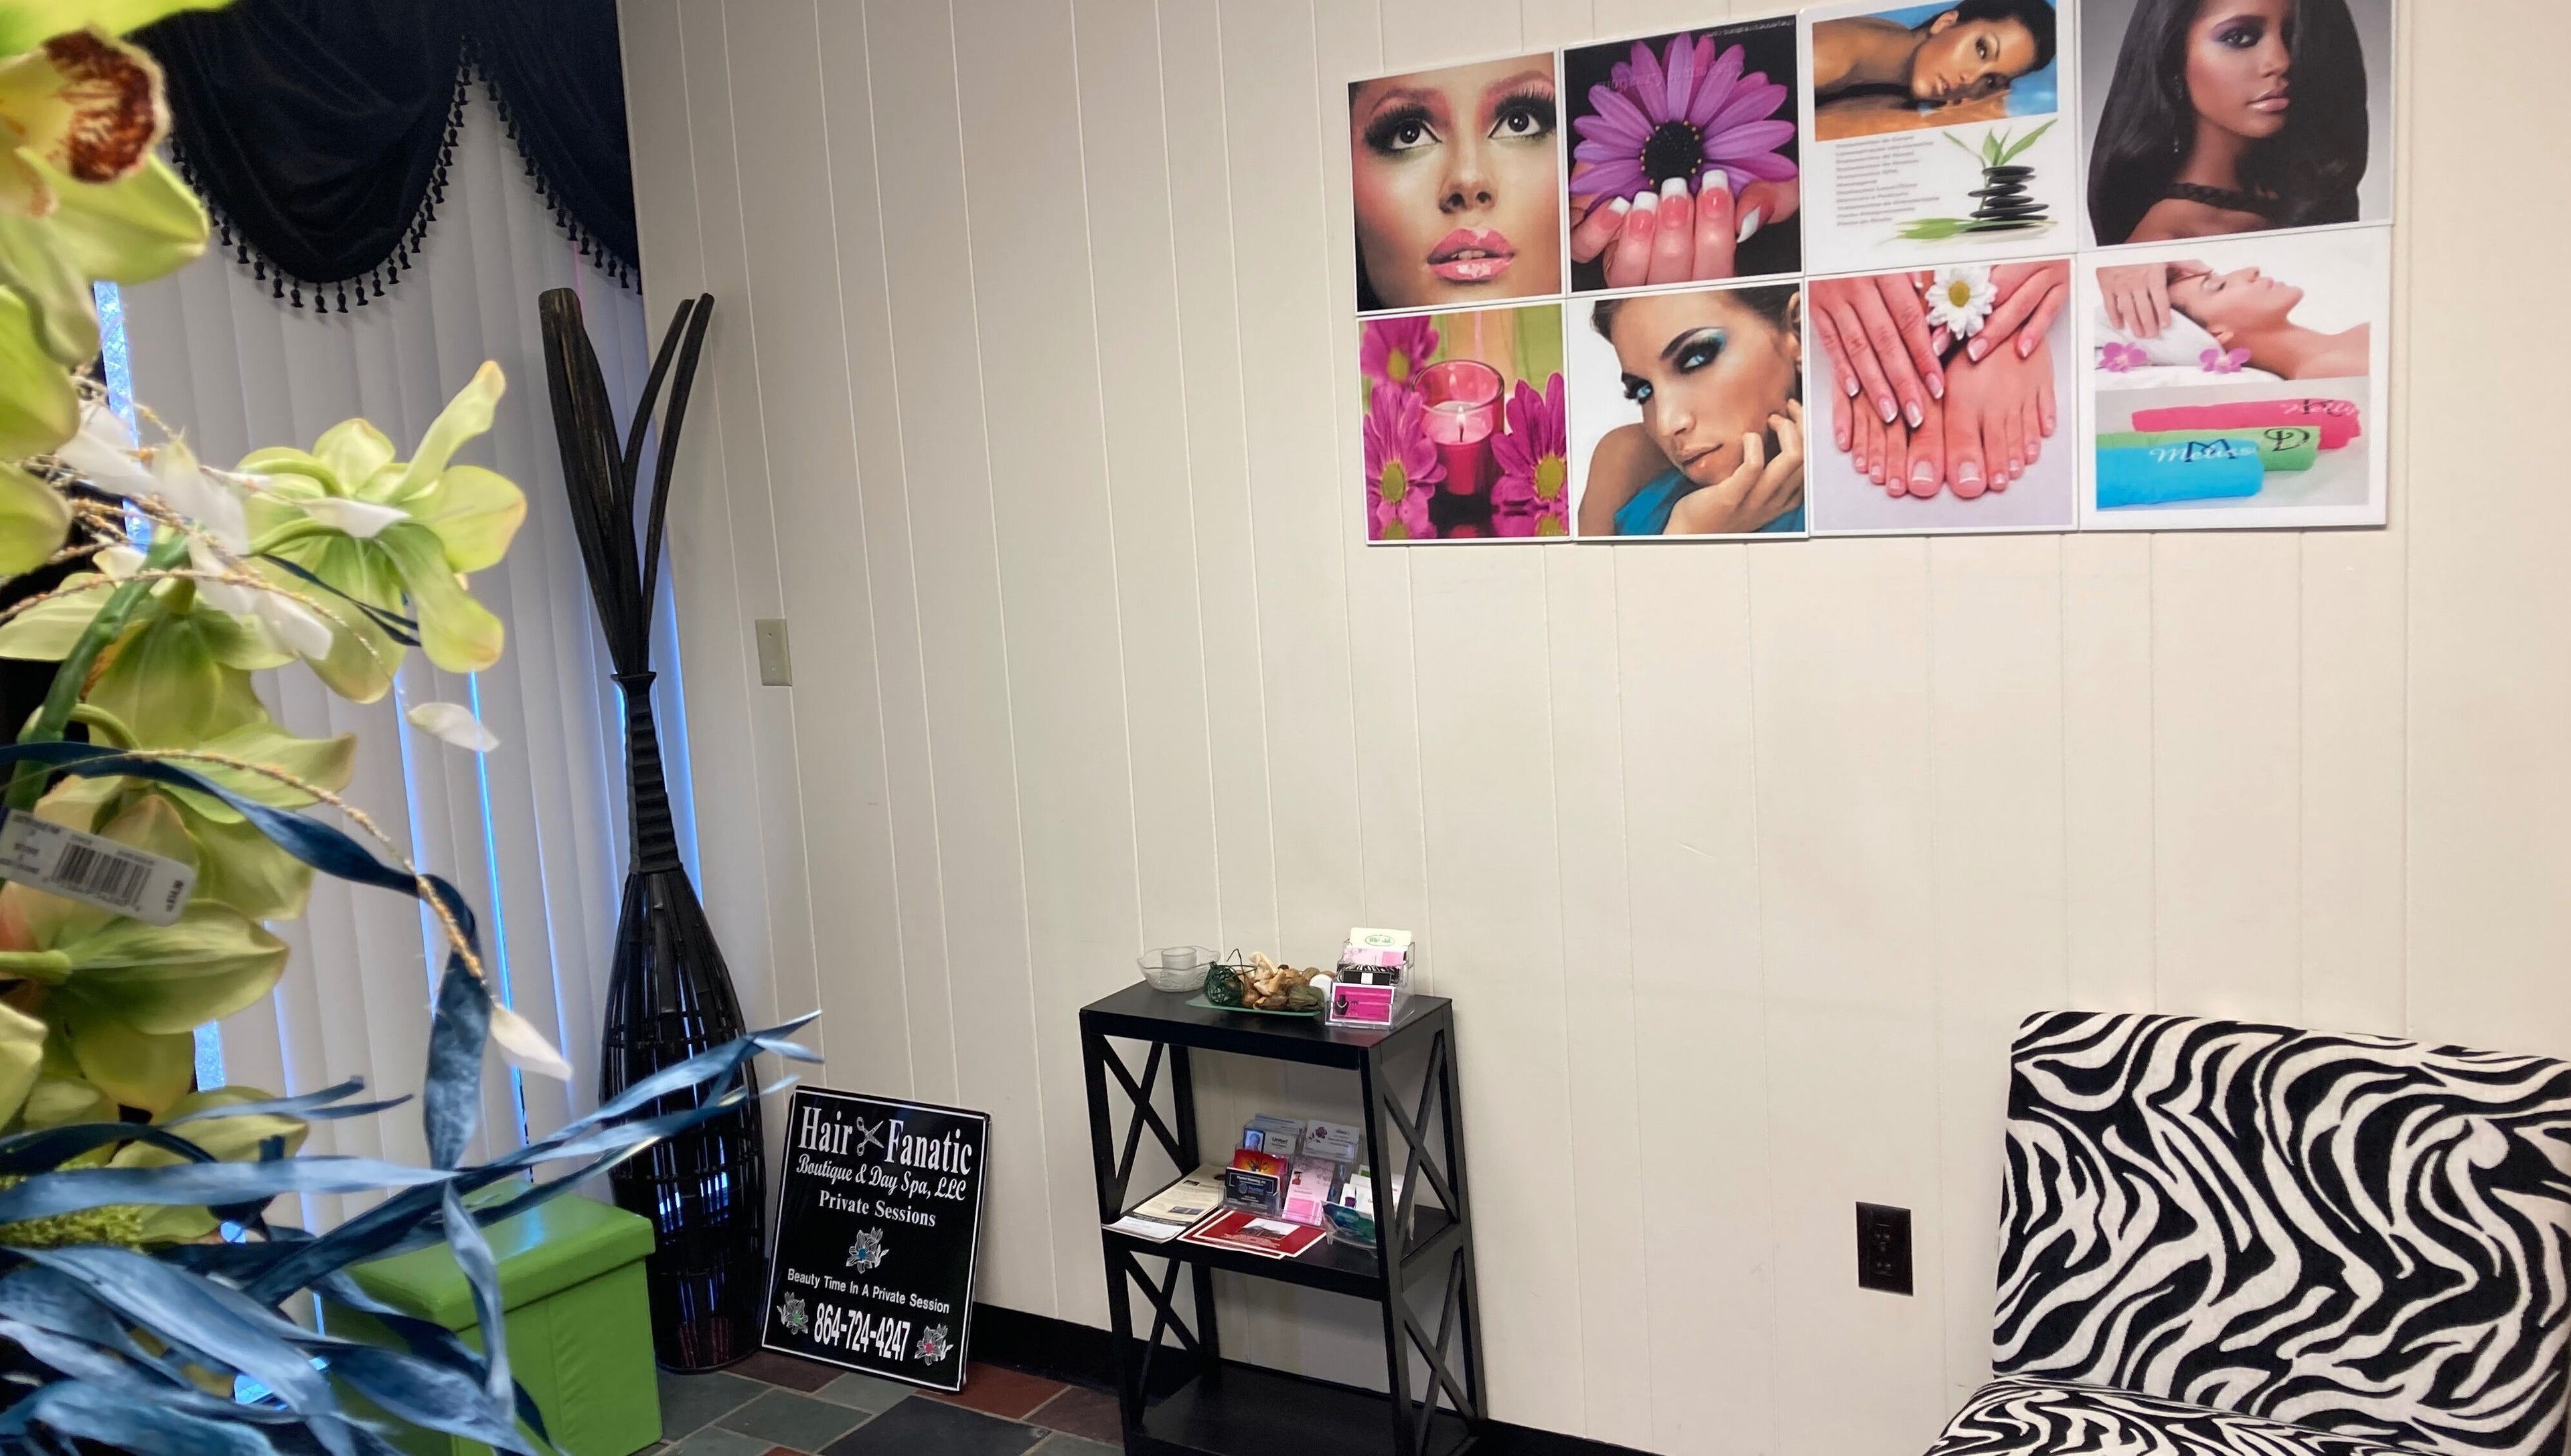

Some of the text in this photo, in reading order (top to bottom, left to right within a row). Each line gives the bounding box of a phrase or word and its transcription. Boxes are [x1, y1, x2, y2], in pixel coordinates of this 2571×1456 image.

[2184, 438, 2239, 463] M
[2264, 427, 2310, 452] D
[797, 1106, 973, 1176] Hair Fanatic
[796, 1153, 967, 1201] Boutique & Day Spa, LLC
[819, 1190, 937, 1227] Private Sessions
[787, 1268, 949, 1314] Beauty Time In A Private Session
[813, 1302, 911, 1362] 864-724-4247
